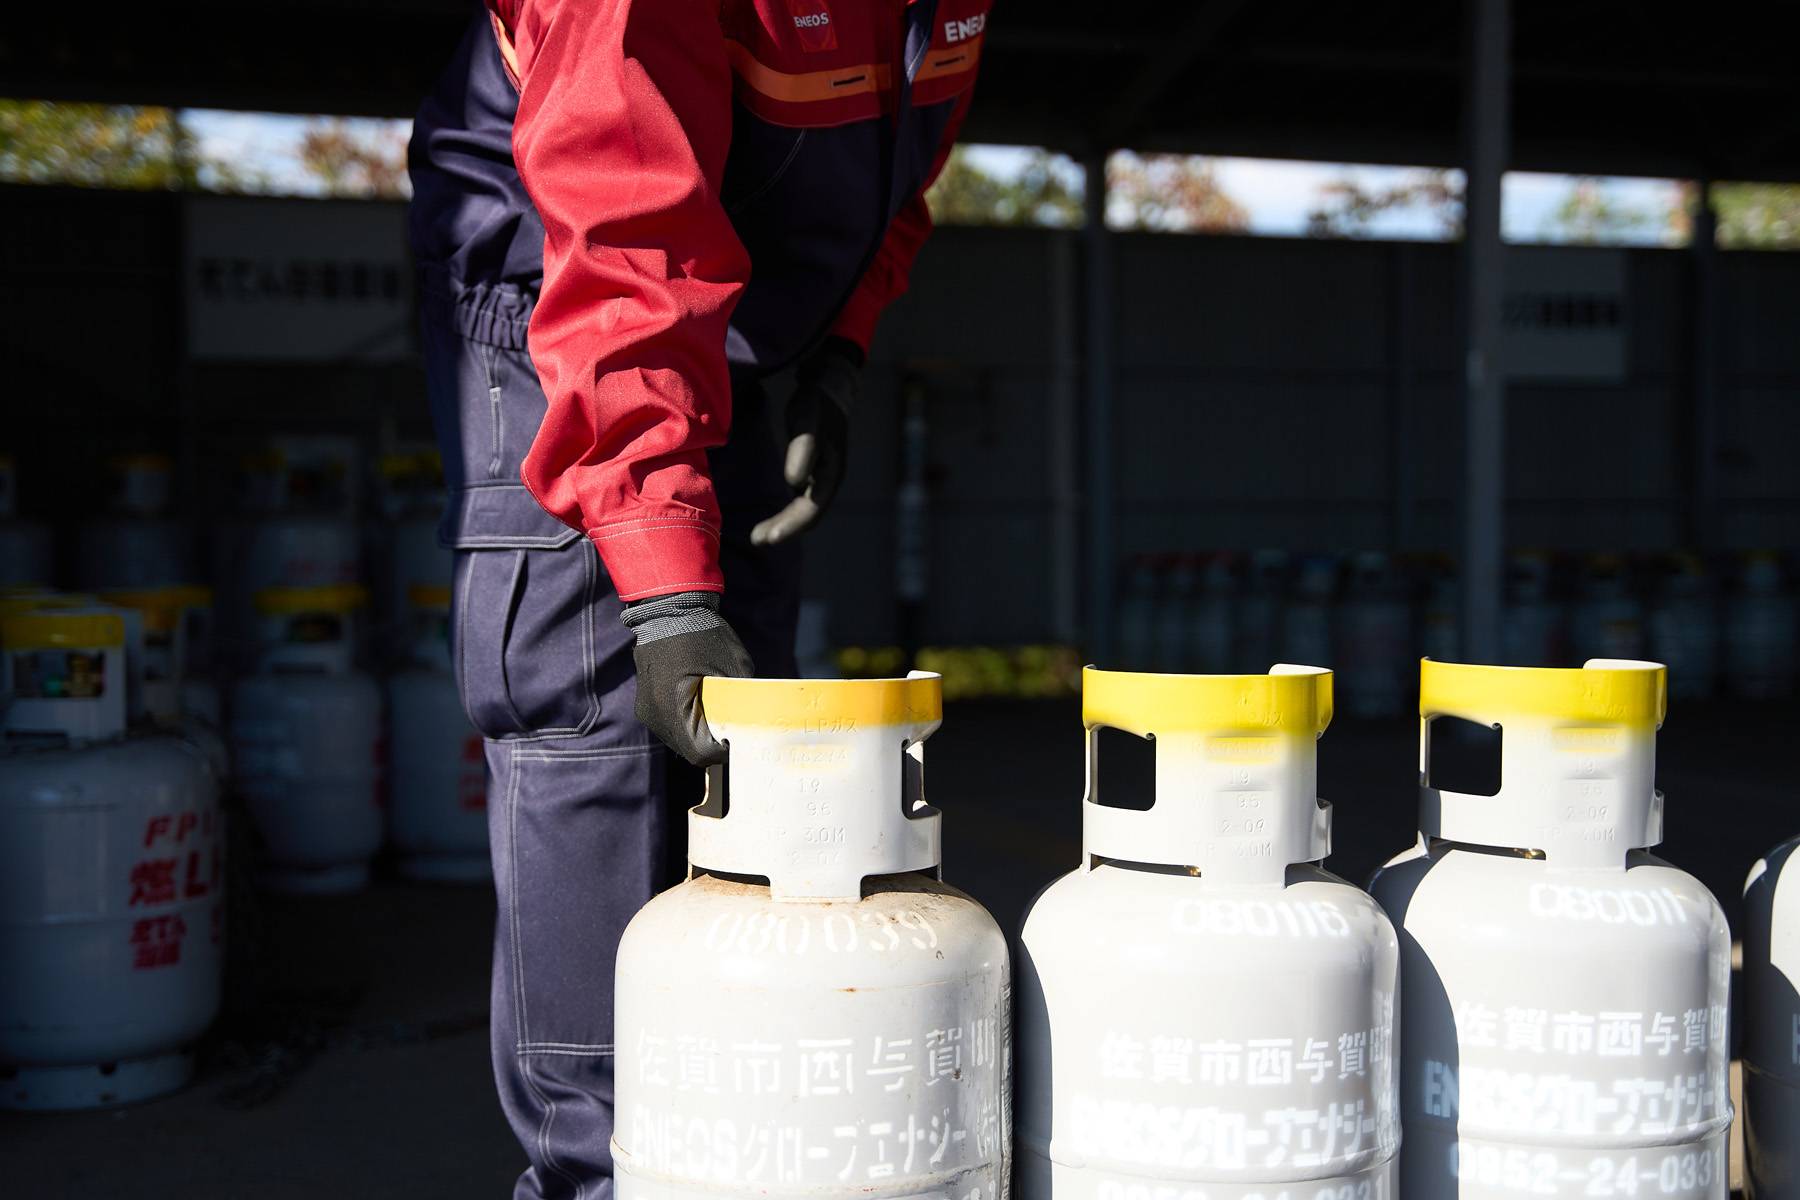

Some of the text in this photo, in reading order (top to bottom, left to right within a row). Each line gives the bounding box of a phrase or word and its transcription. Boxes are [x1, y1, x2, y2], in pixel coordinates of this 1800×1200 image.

[793, 12, 829, 28] ENEOS
[704, 910, 938, 956] 080039
[1174, 898, 1350, 937] 080116
[1450, 1142, 1721, 1197] 0952-24-0331
